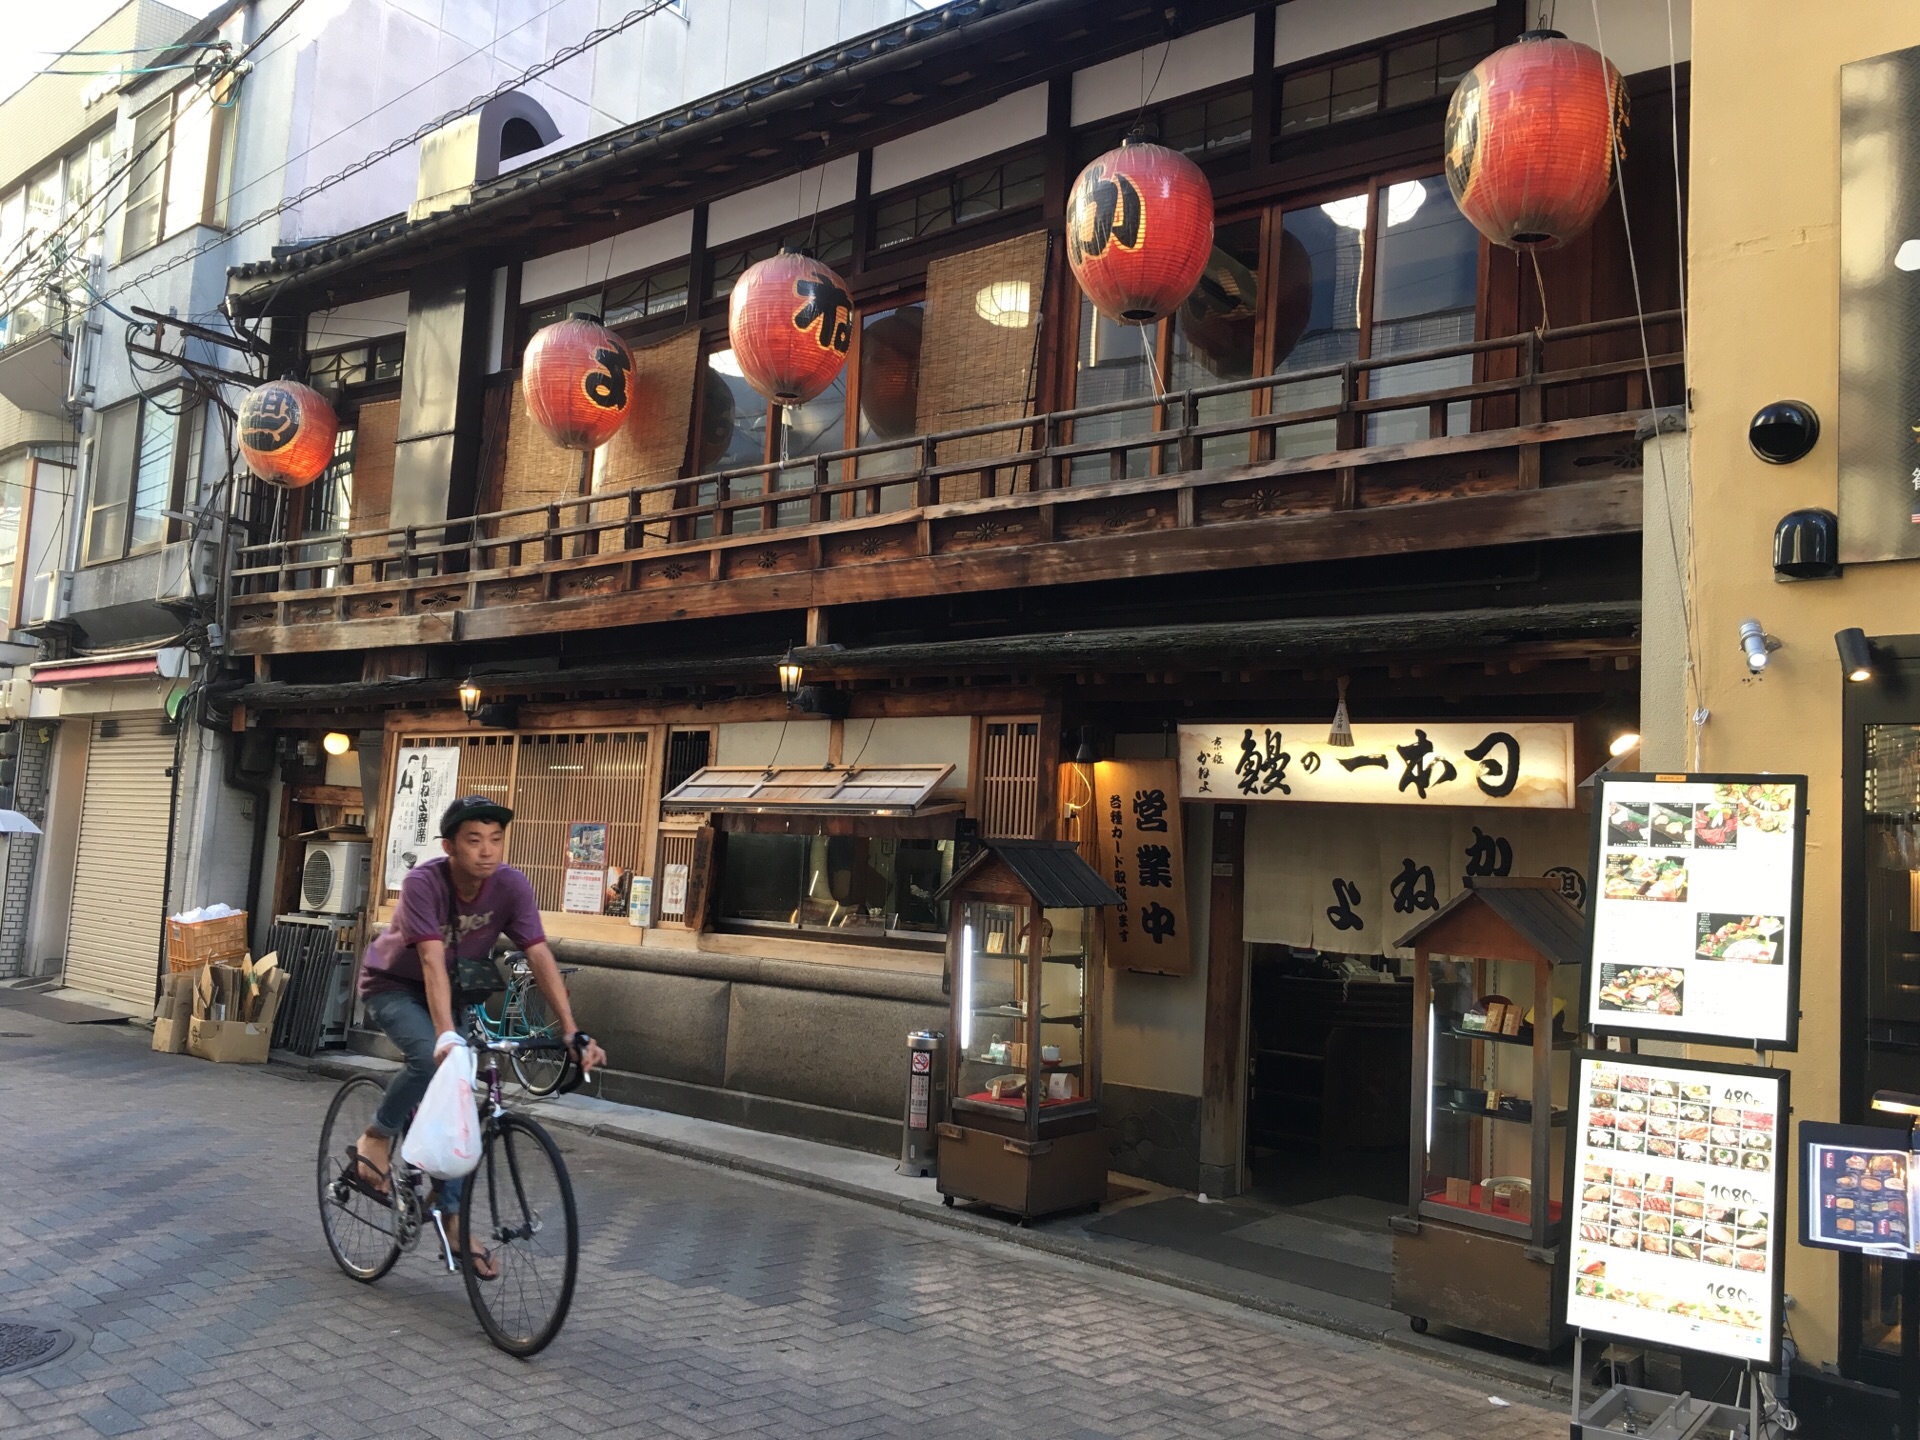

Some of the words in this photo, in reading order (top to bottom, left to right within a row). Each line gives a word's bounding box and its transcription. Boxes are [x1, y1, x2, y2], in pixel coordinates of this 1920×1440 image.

[1197, 750, 1213, 793] かねよ
[1133, 789, 1176, 945] 営業中
